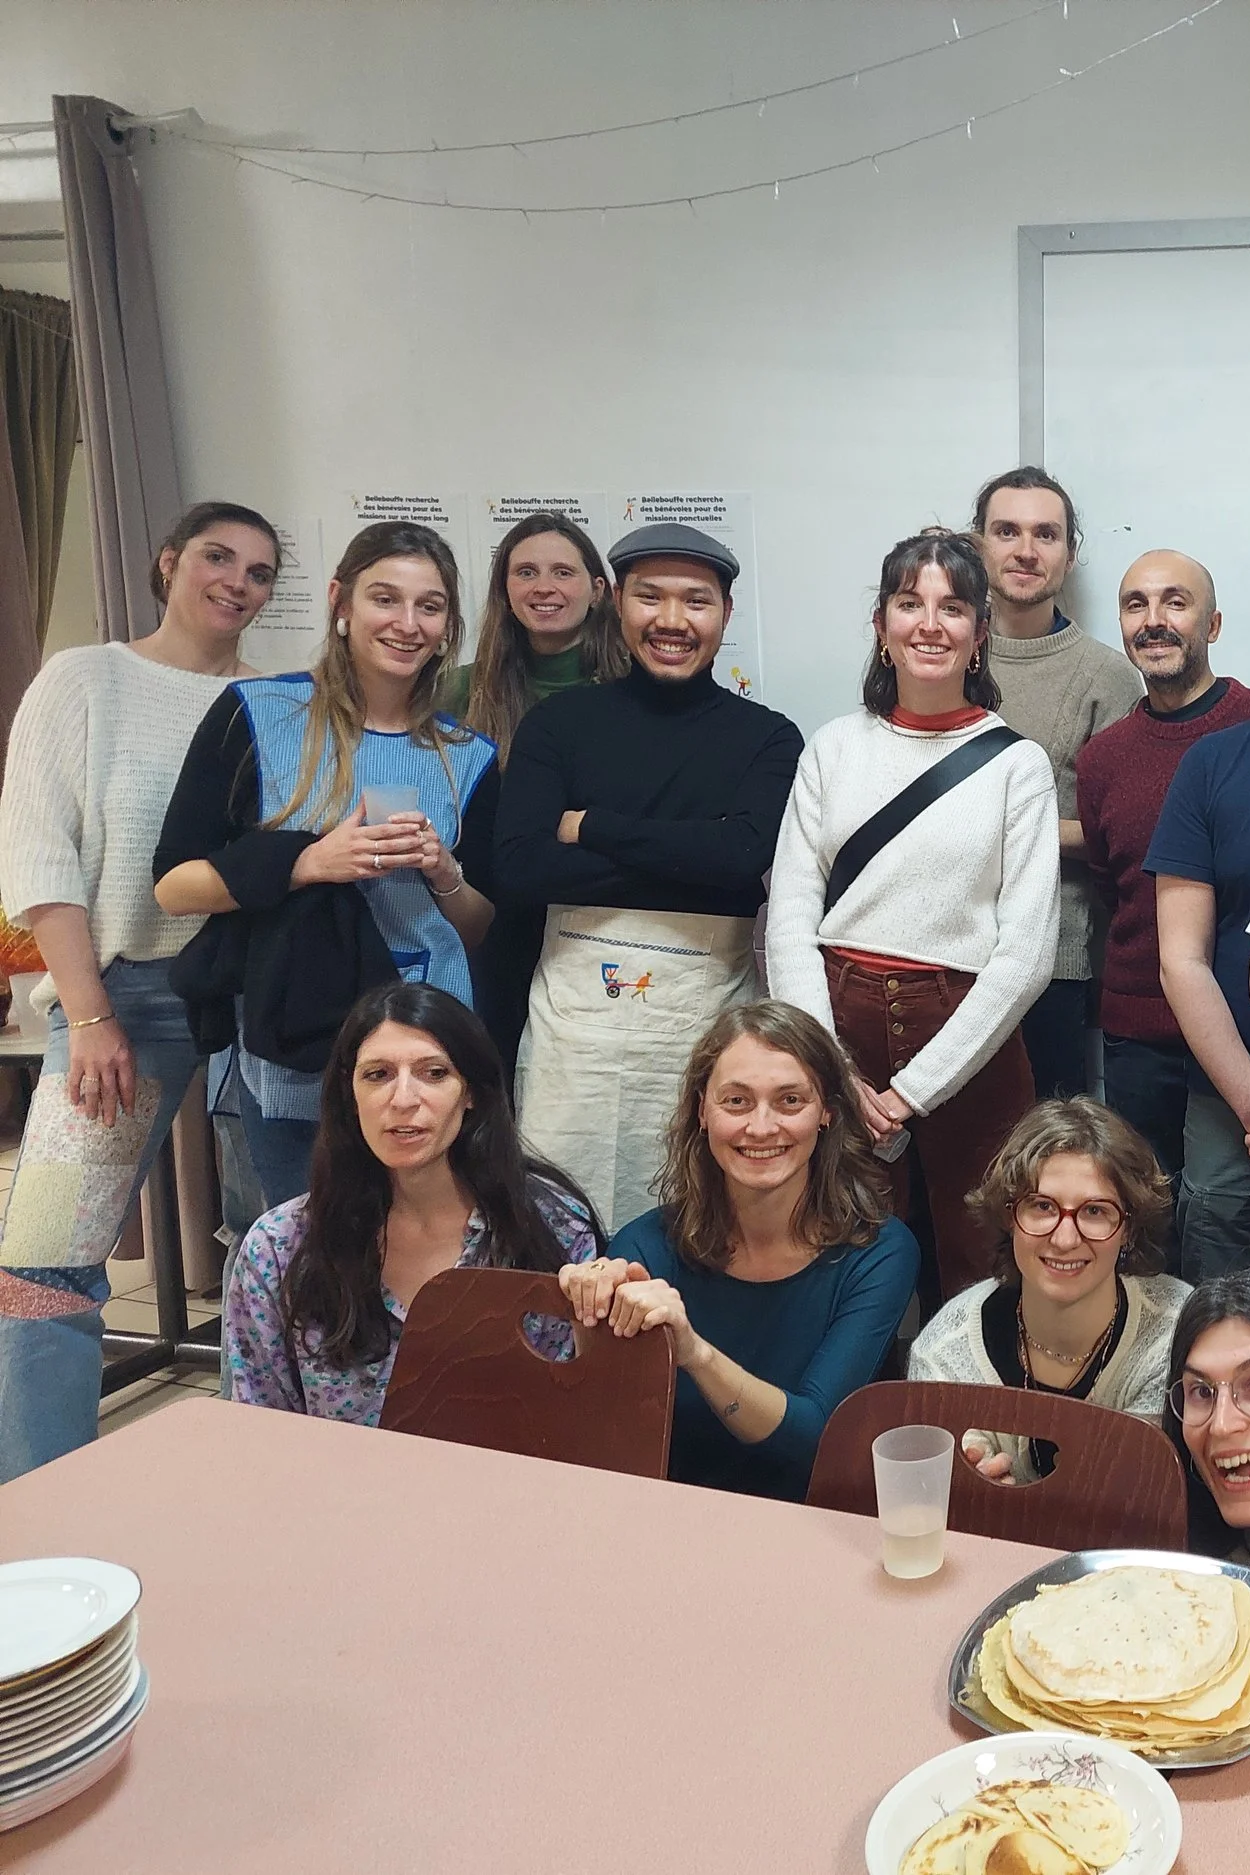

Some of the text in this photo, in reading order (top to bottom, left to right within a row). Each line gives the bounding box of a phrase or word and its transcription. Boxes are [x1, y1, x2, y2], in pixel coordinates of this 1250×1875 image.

[365, 495, 439, 504] Bellebouffe recherche
[501, 497, 541, 505] Bellebouffe
[654, 505, 692, 513] bénévoles
[358, 512, 386, 520] missions
[411, 514, 431, 522] temps
[433, 515, 449, 523] long
[572, 516, 589, 524] long
[678, 515, 723, 523] ponctuelles
